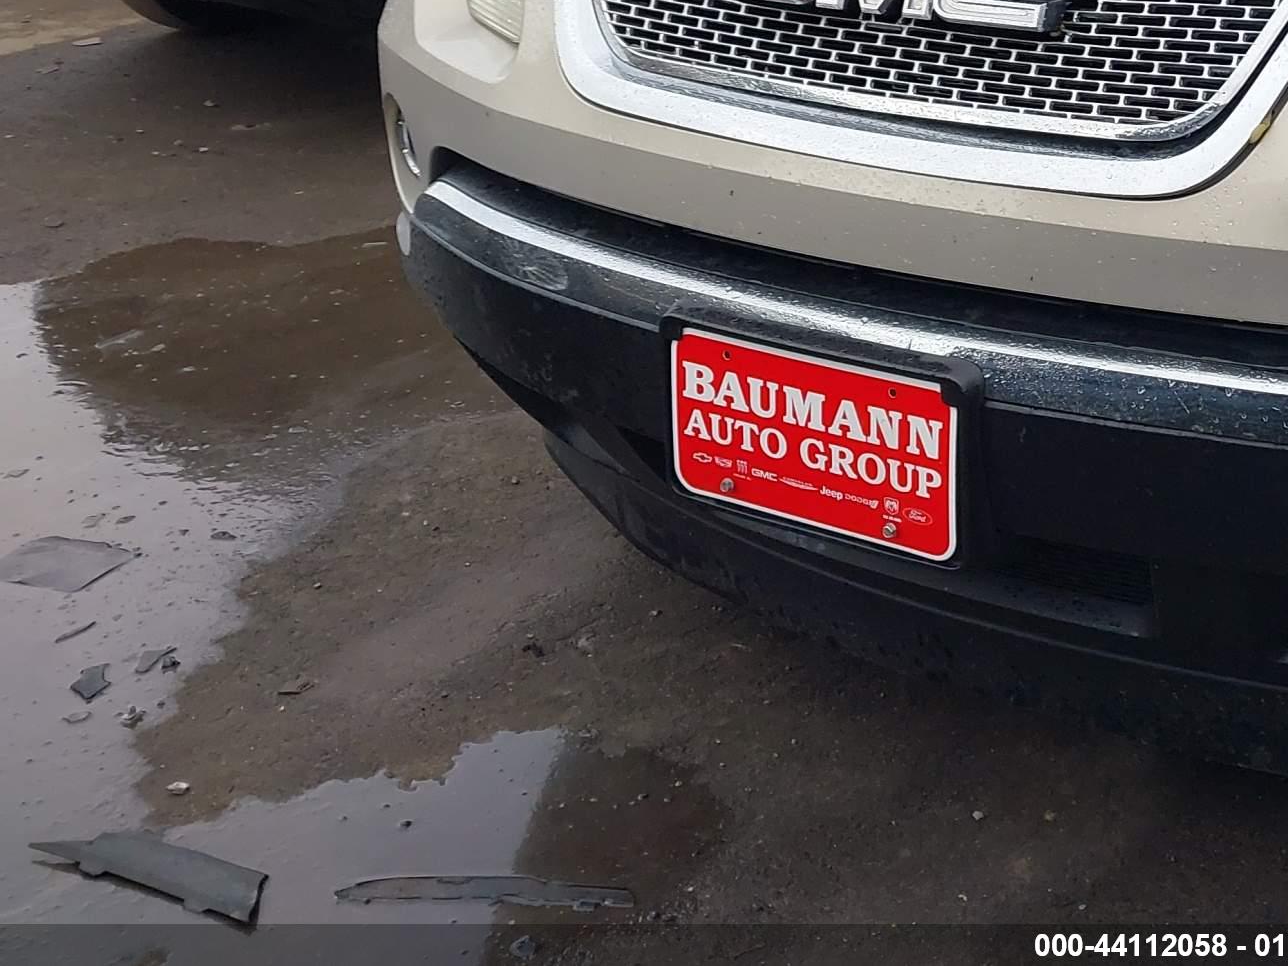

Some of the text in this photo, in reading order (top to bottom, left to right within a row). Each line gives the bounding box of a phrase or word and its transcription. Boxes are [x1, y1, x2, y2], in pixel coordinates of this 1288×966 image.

[681, 360, 944, 461] BAUMANN
[683, 408, 943, 499] AUTO GROUP
[751, 468, 779, 483] GMC
[819, 485, 844, 501] Jeep
